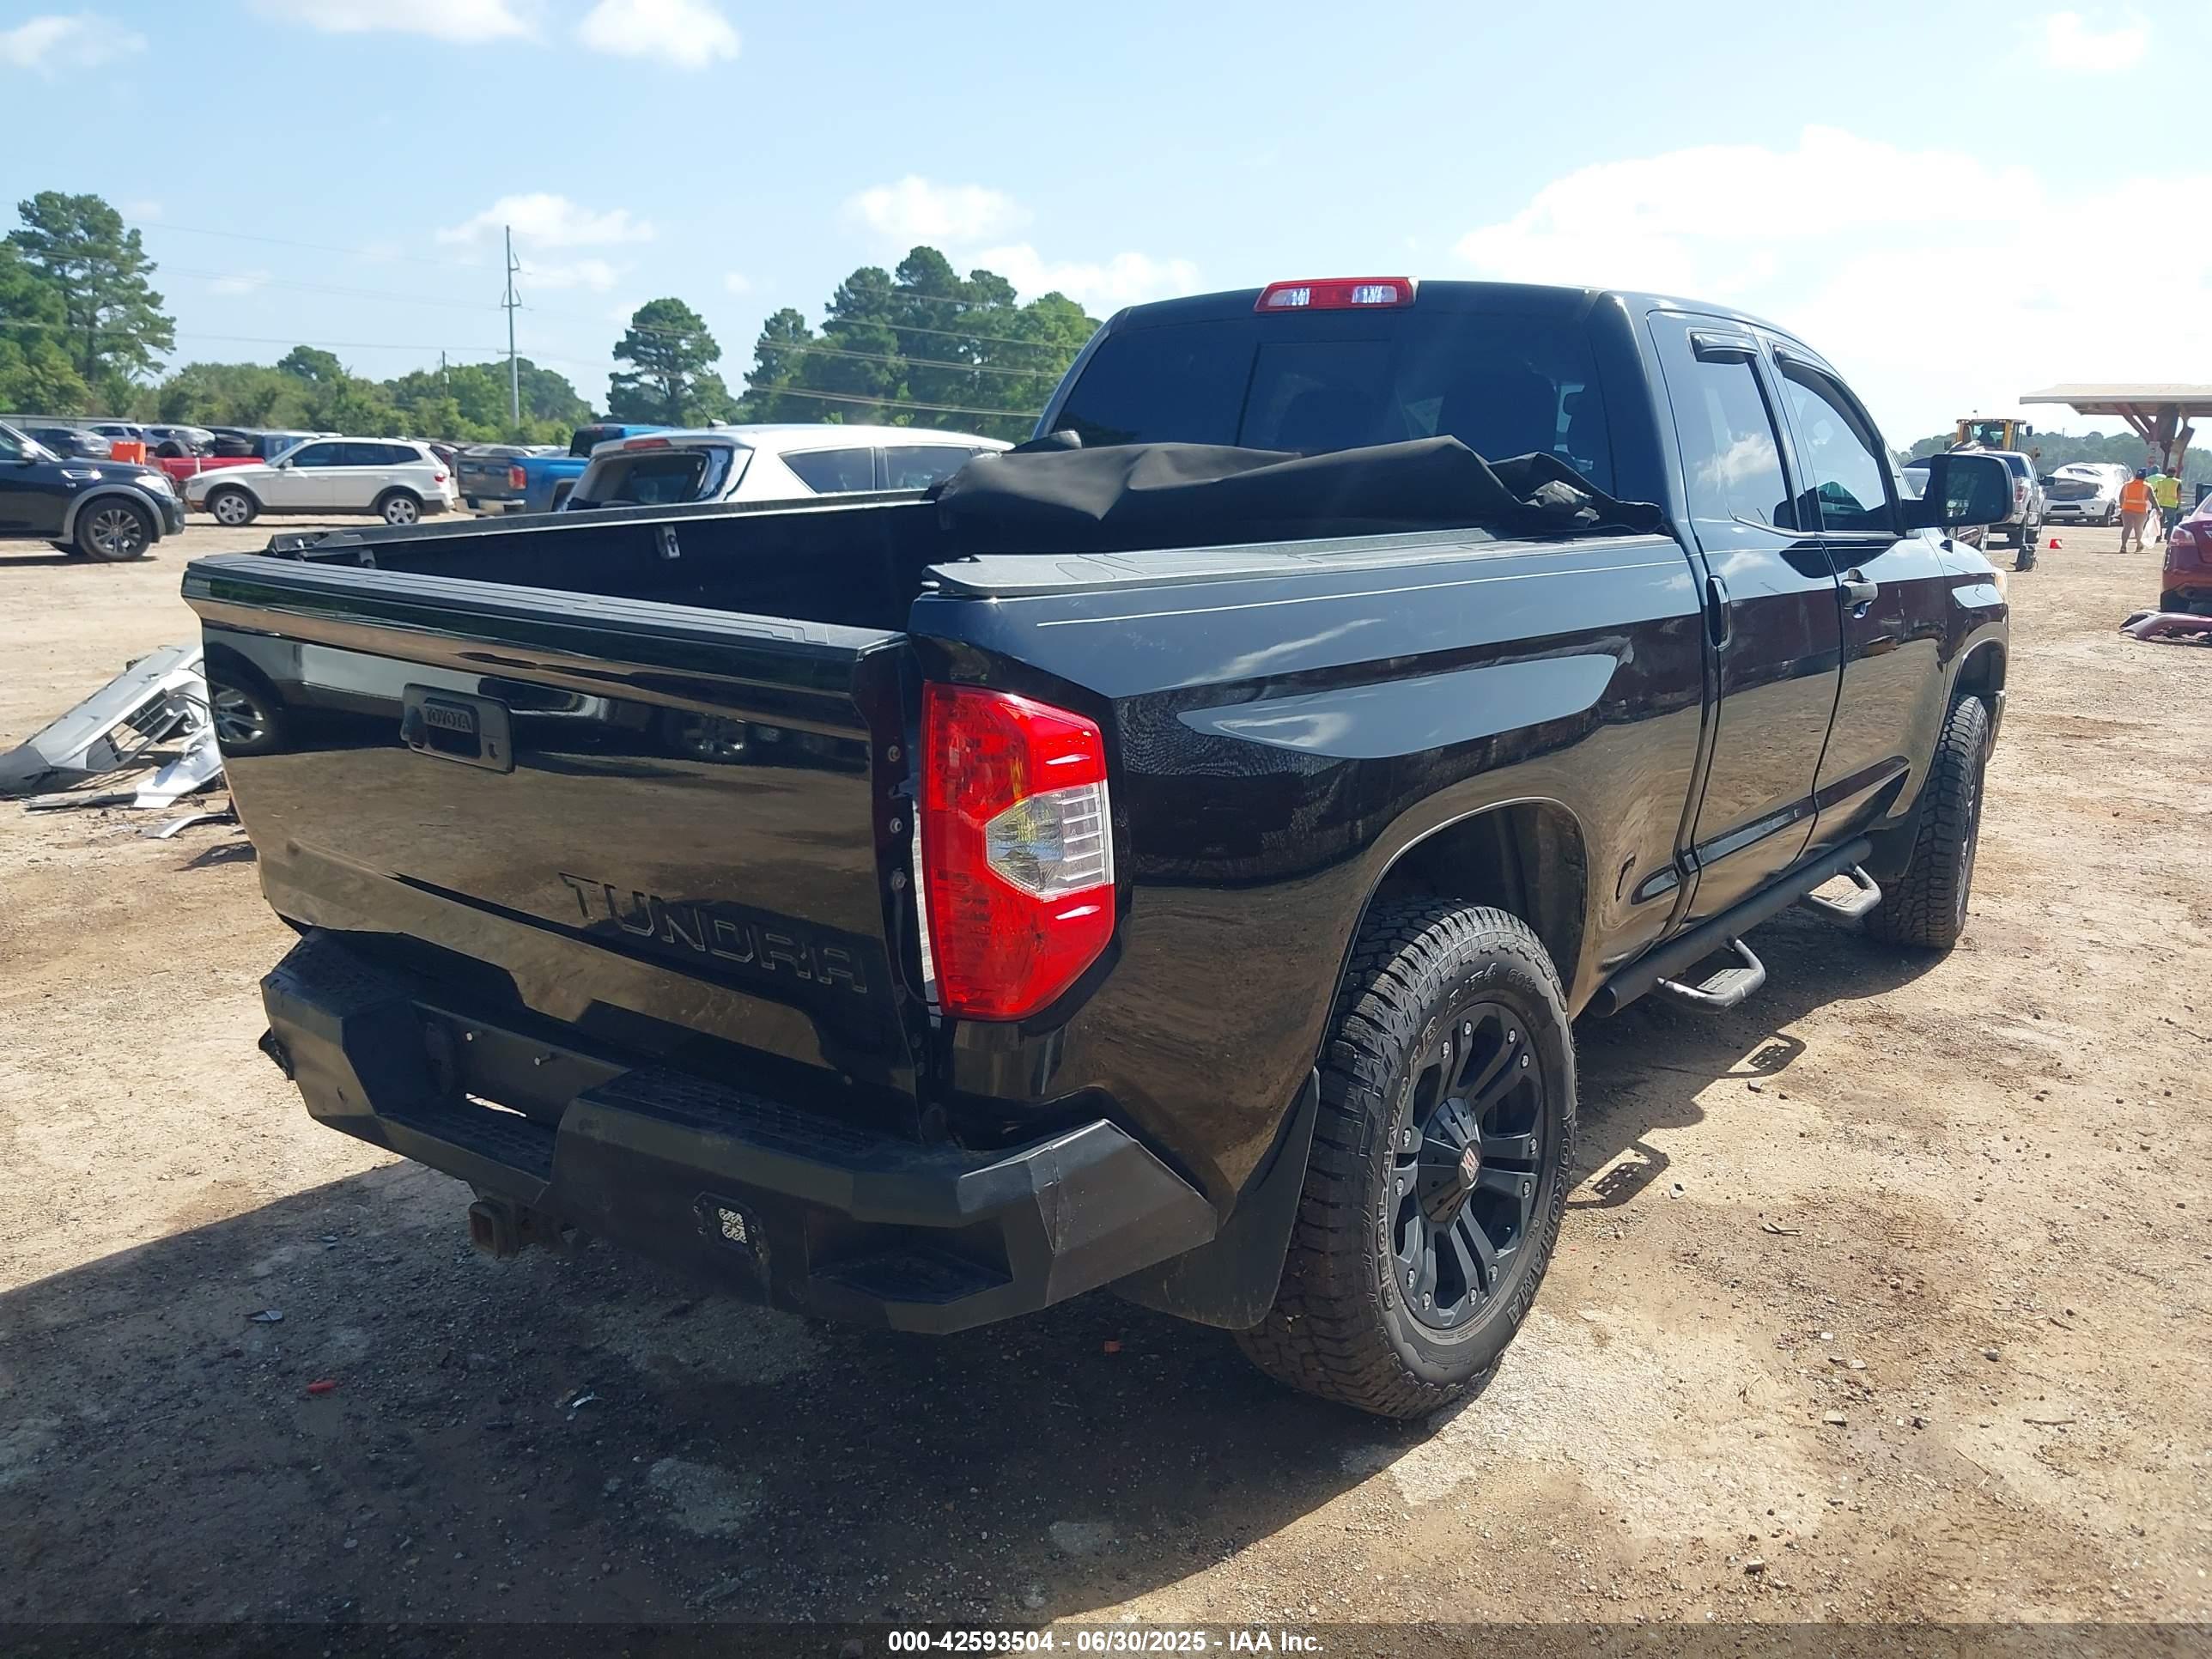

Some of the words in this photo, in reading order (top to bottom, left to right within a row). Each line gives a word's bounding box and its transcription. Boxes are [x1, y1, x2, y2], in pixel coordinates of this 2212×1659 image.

[426, 707, 471, 731] TOYOTA
[558, 872, 867, 993] TUNDRA
[1506, 1110, 1575, 1327] YOKOHAMA
